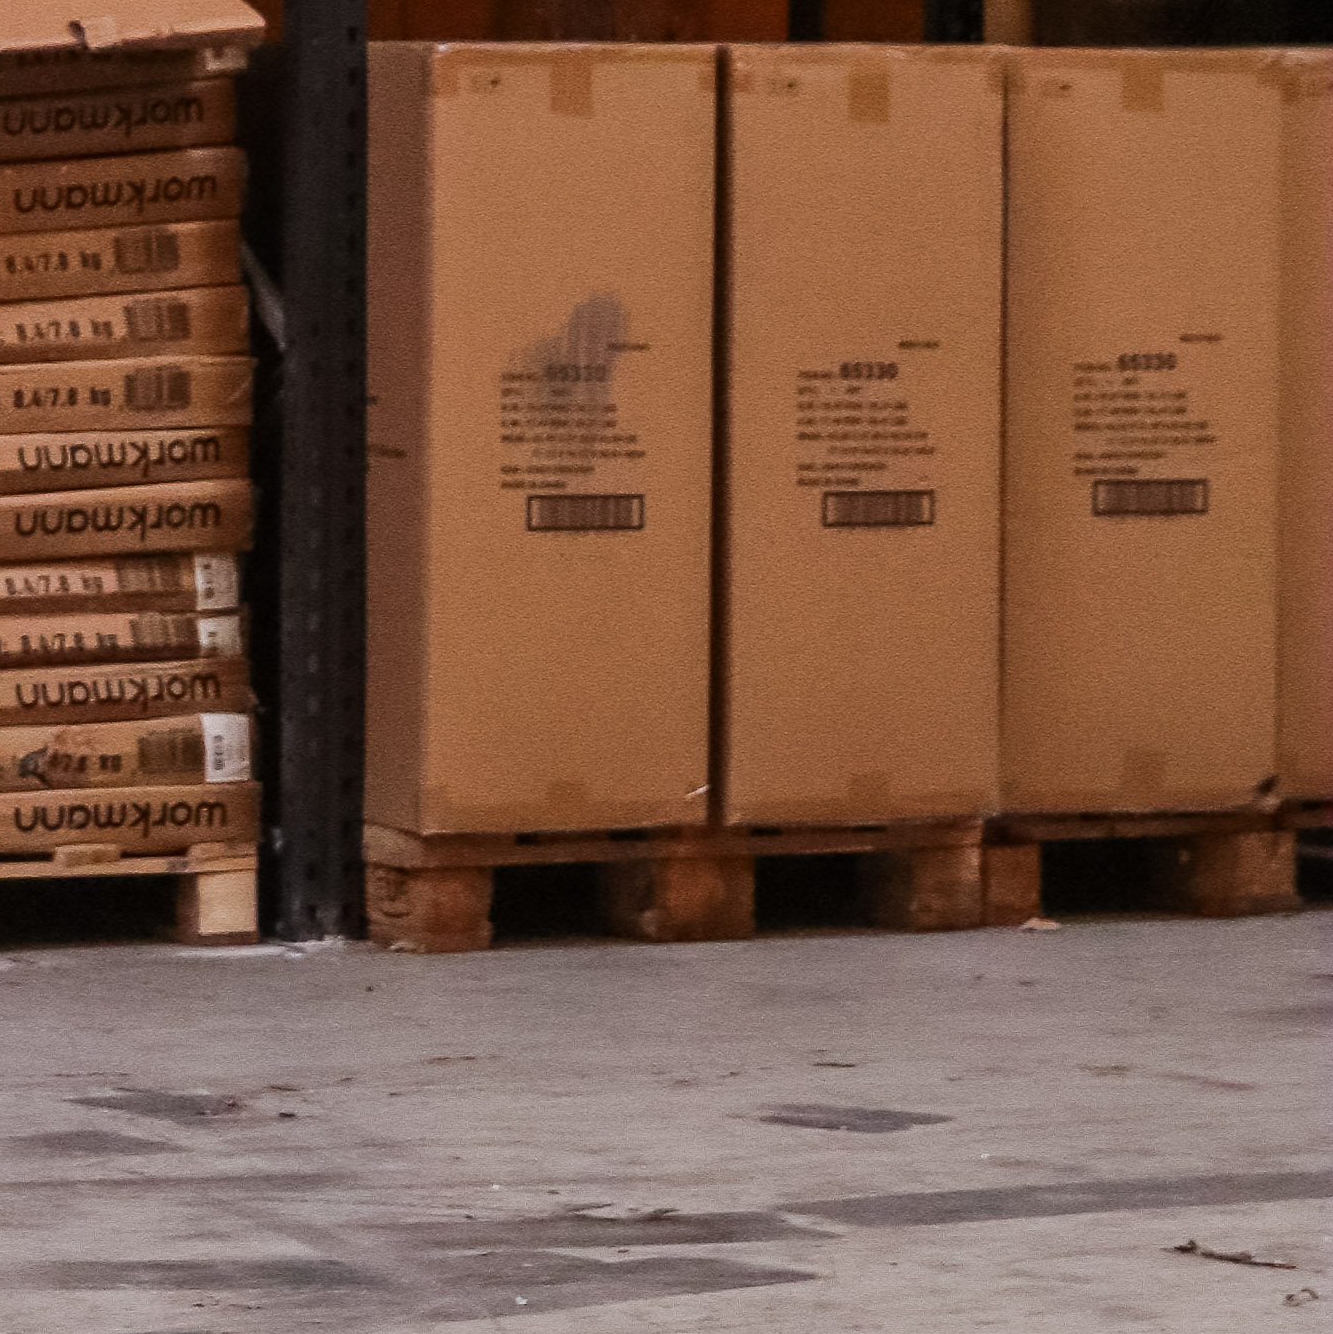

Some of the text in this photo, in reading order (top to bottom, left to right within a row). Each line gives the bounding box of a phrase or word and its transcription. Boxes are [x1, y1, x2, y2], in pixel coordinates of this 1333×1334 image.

[3, 99, 204, 136] workmann
[14, 176, 217, 212] workmann
[18, 437, 221, 479] workmann
[15, 502, 221, 540] workmann
[16, 673, 222, 710] workmann
[14, 799, 227, 834] workmann
